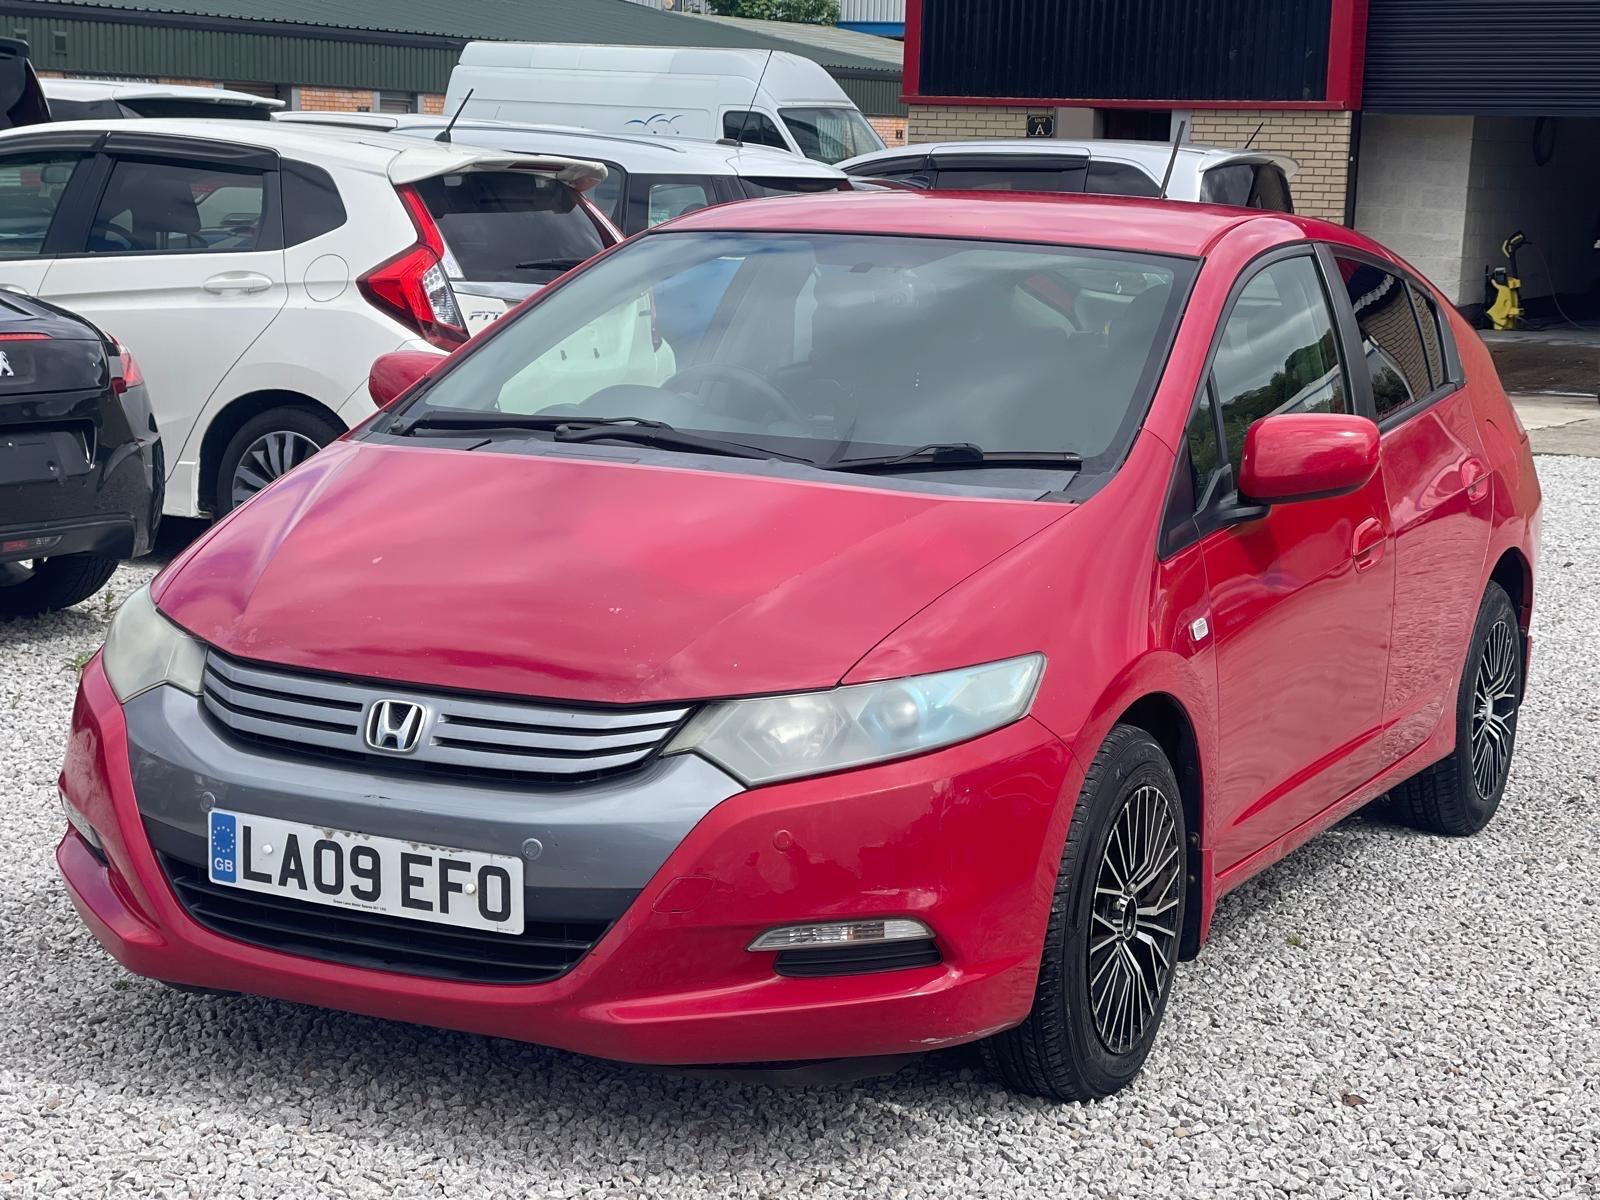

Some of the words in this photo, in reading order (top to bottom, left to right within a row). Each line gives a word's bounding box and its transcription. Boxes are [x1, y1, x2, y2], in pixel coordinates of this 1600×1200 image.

[1035, 123, 1045, 134] A
[214, 857, 234, 873] GB
[242, 825, 382, 903] LA09
[400, 851, 511, 923] EFO
